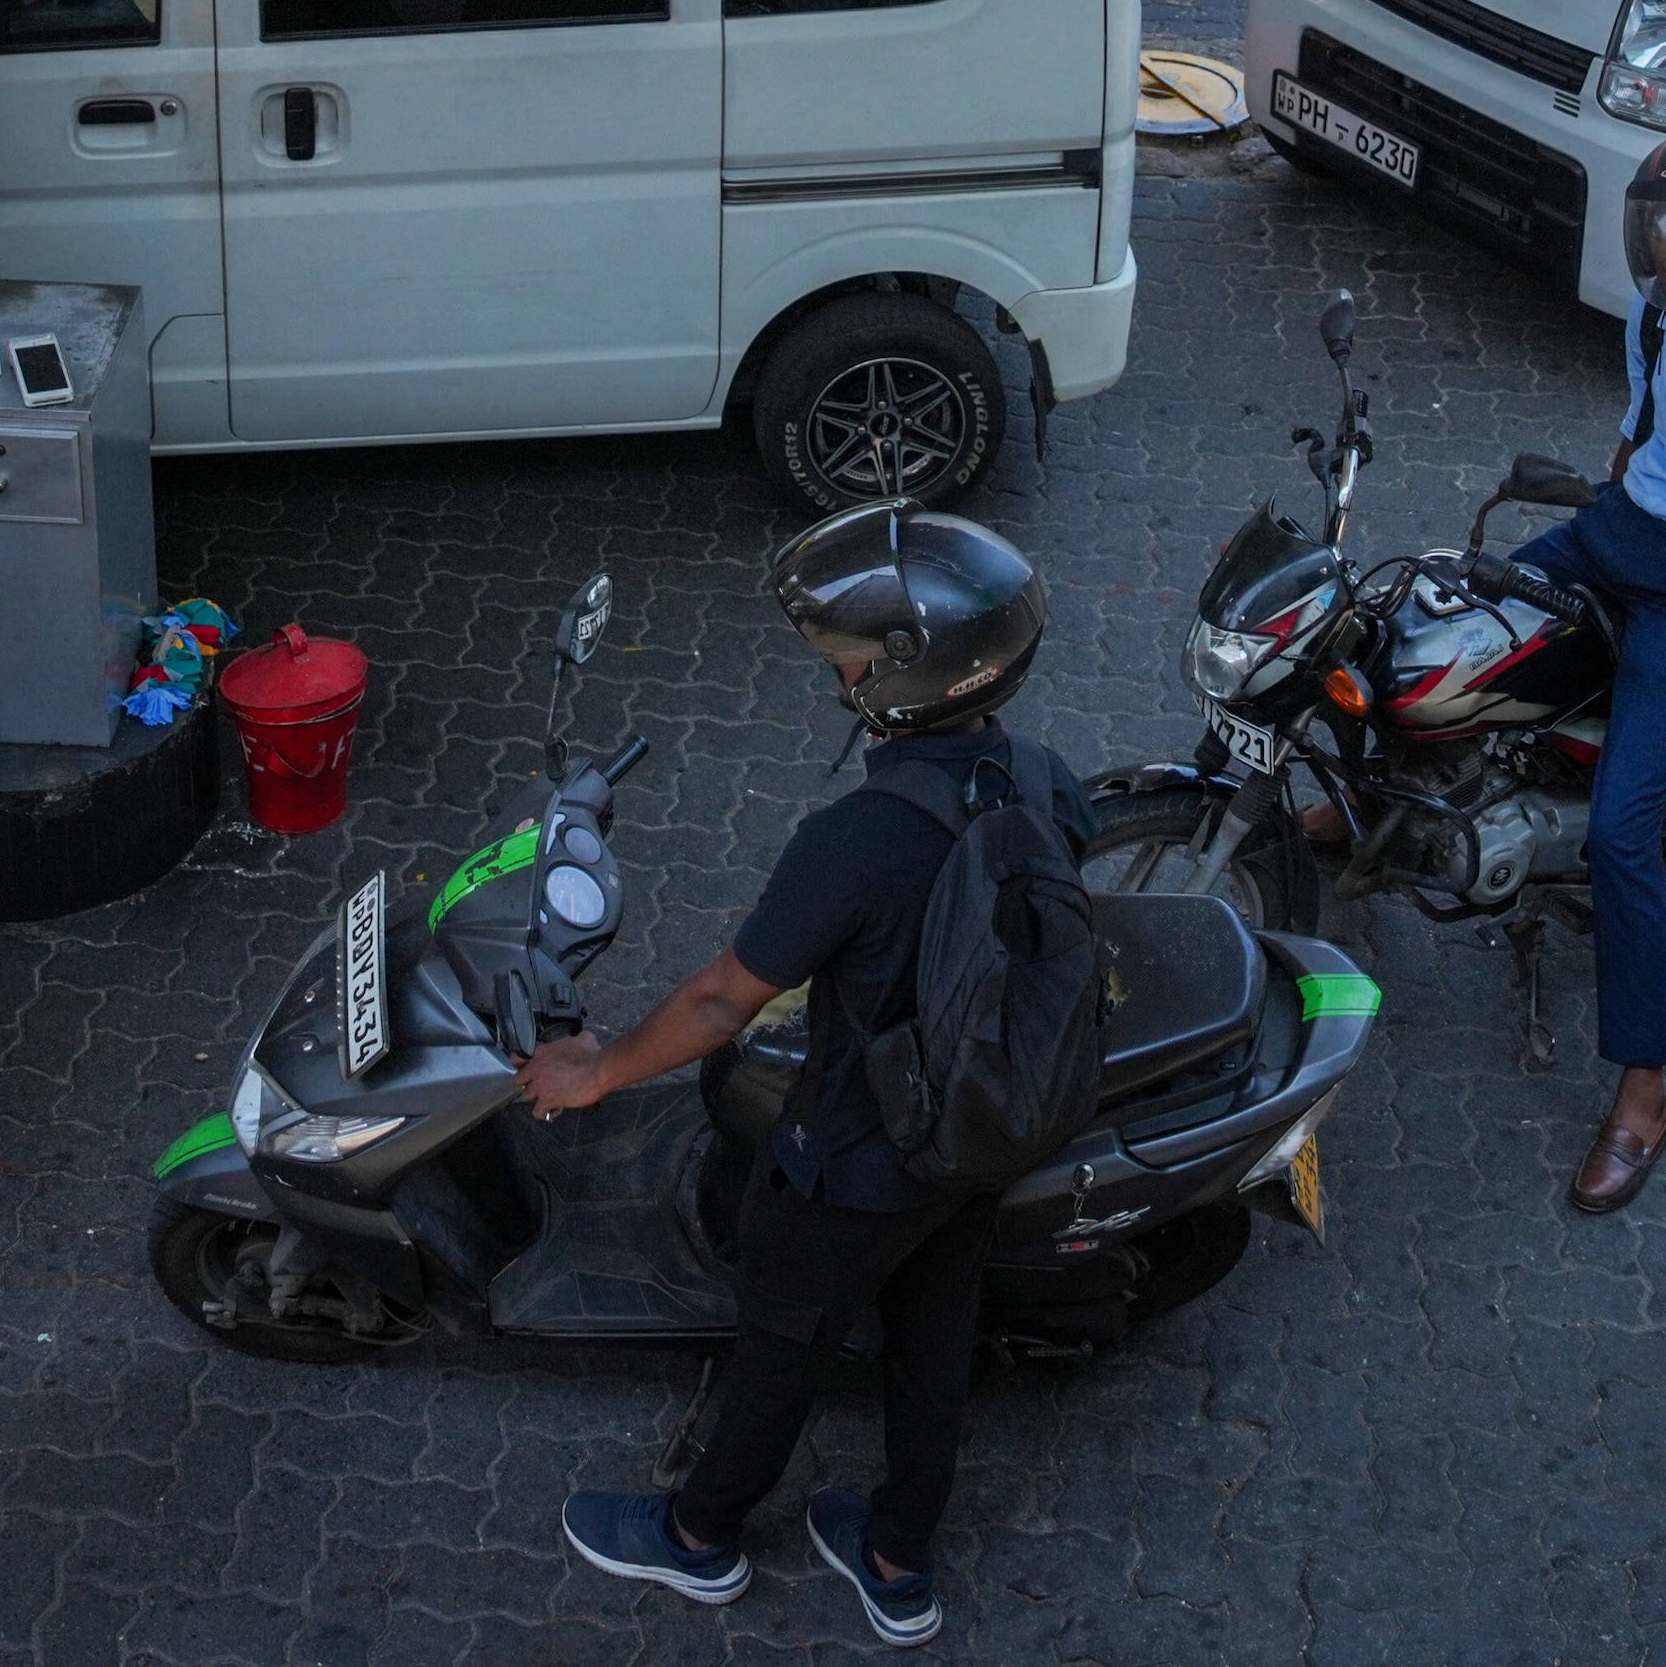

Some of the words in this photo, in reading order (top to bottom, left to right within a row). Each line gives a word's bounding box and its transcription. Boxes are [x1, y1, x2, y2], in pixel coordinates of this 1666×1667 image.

[958, 371, 989, 486] LINGLONG
[1469, 643, 1504, 671] BAJAJ
[351, 890, 366, 922] WP
